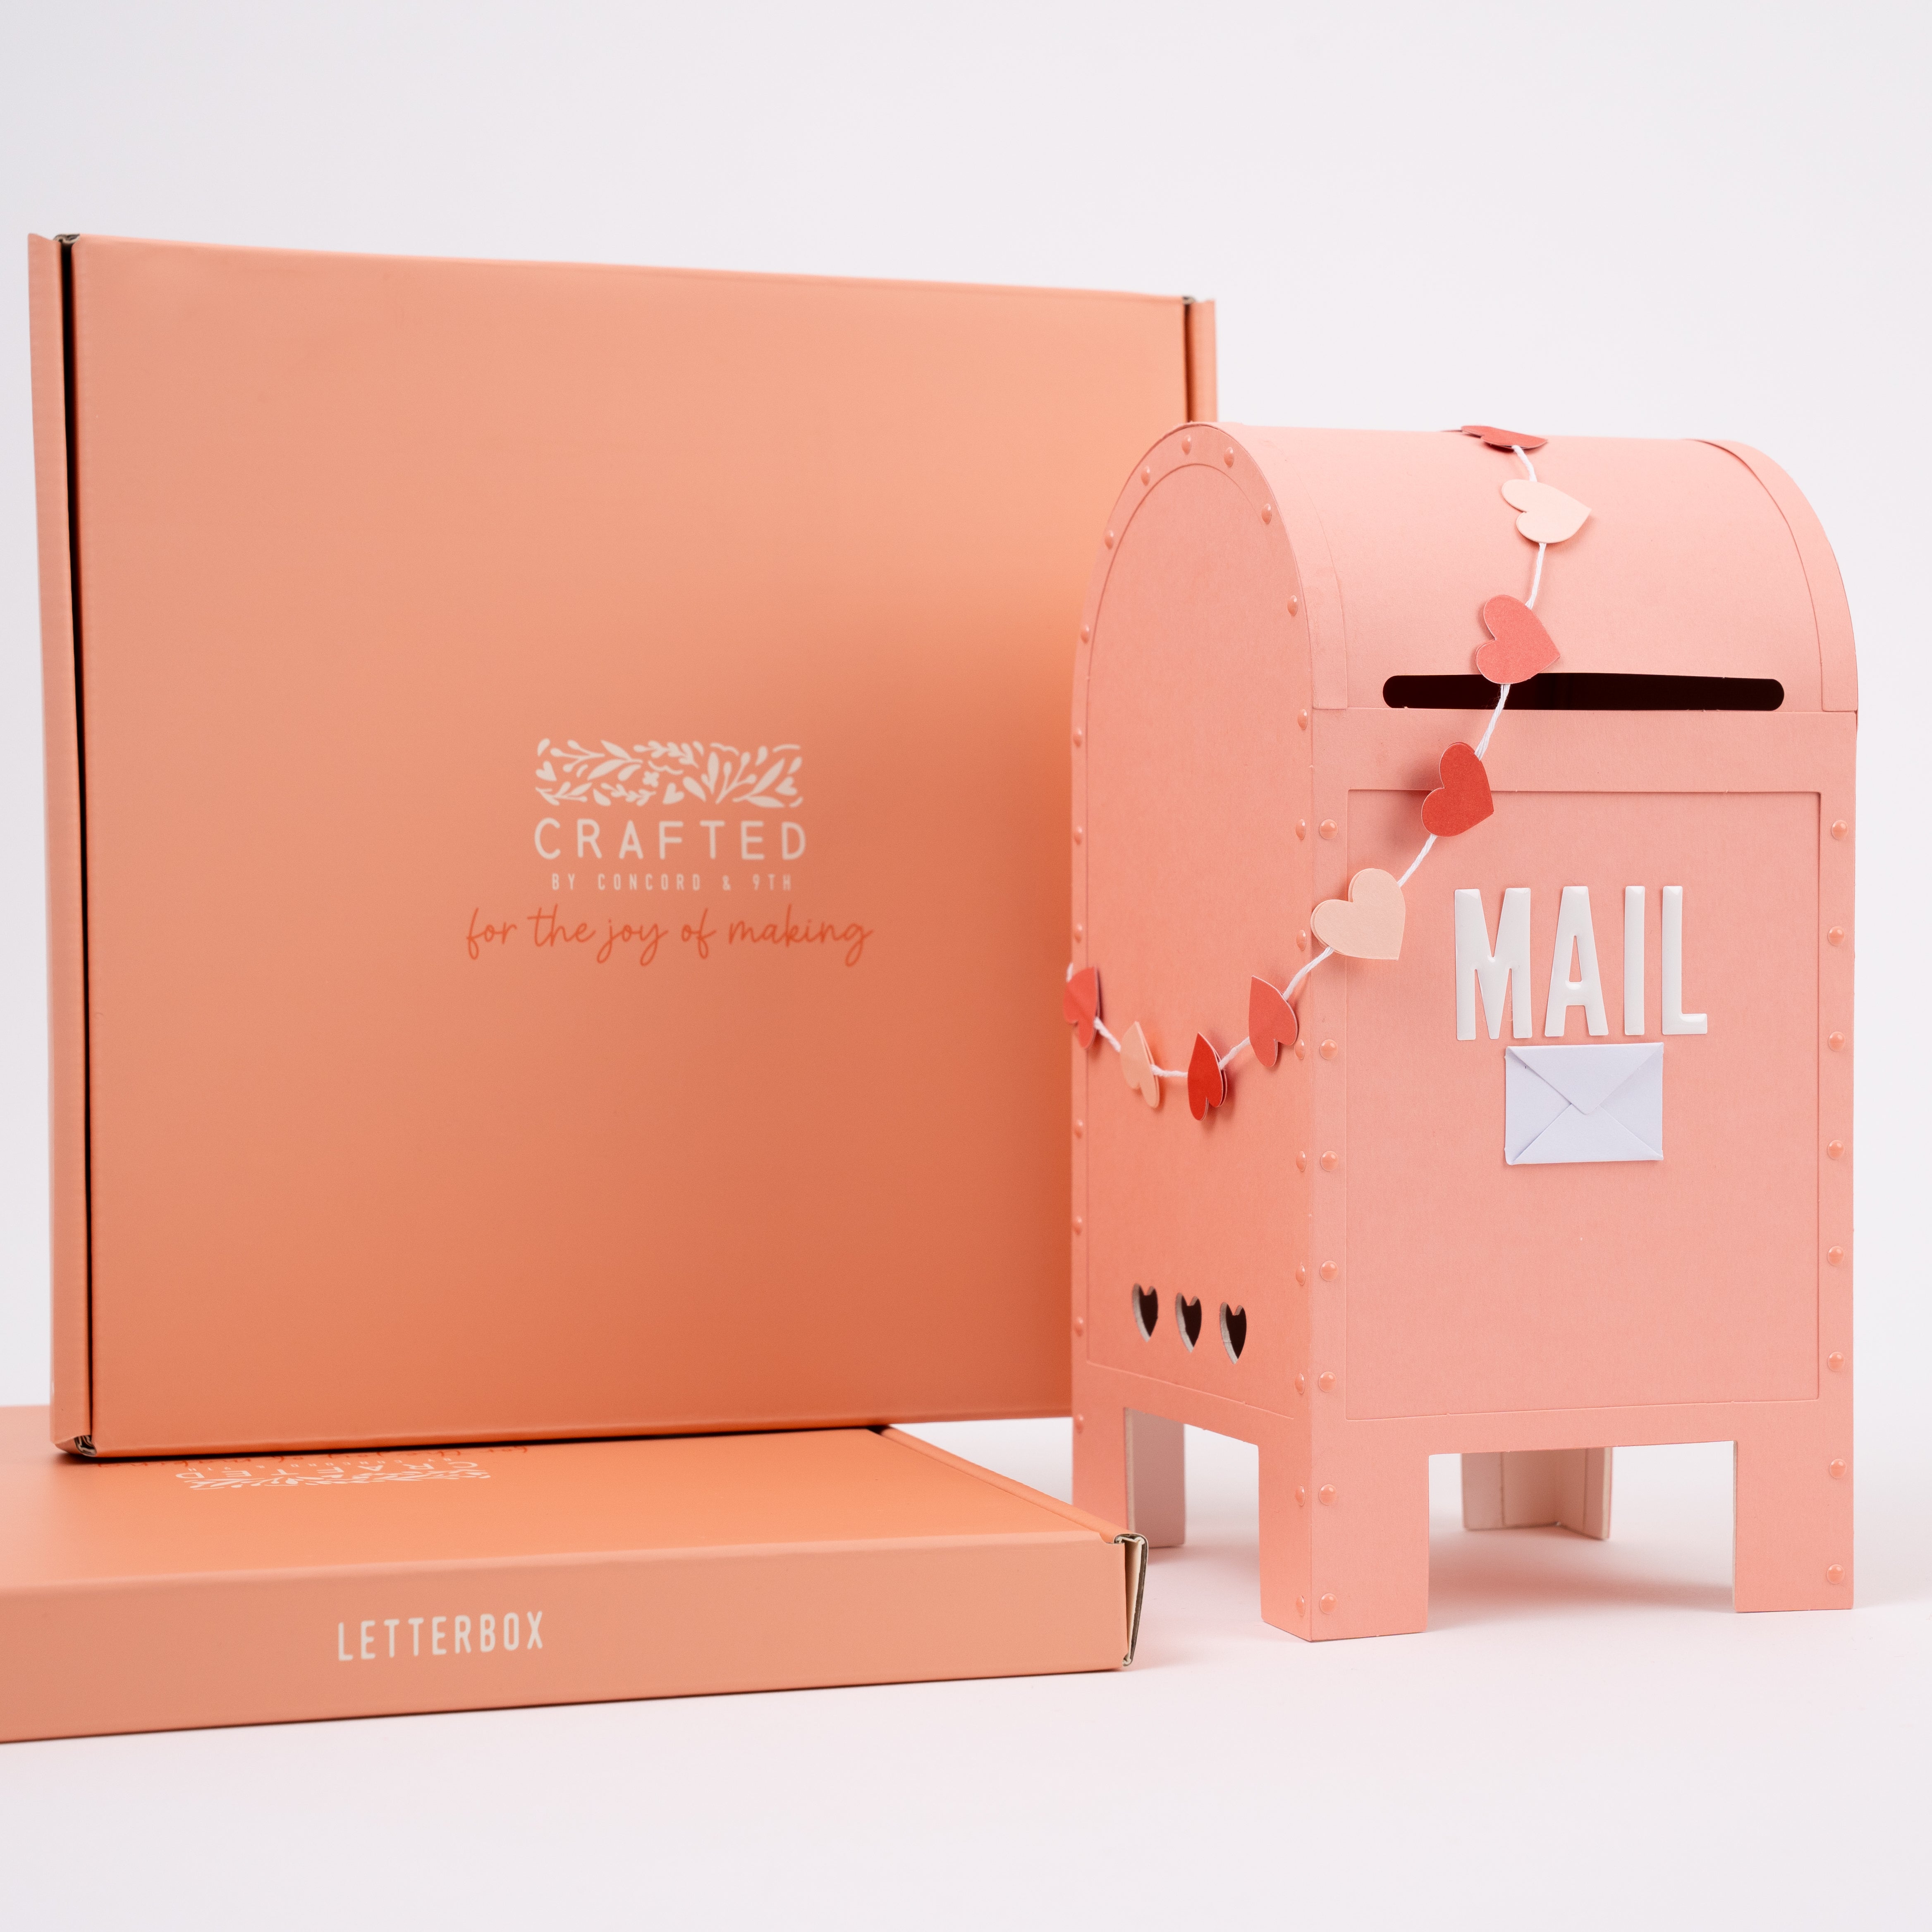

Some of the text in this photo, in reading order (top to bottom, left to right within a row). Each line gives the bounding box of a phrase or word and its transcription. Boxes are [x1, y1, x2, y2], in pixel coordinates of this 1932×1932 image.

[534, 817, 806, 861] CRAFTED
[551, 873, 792, 891] BY CONCORD & 9TH
[466, 903, 875, 967] for the joy of making
[1454, 885, 1708, 1041] MAIL
[175, 1461, 478, 1478] CRAFTED
[338, 1610, 543, 1662] LETTERBOX
